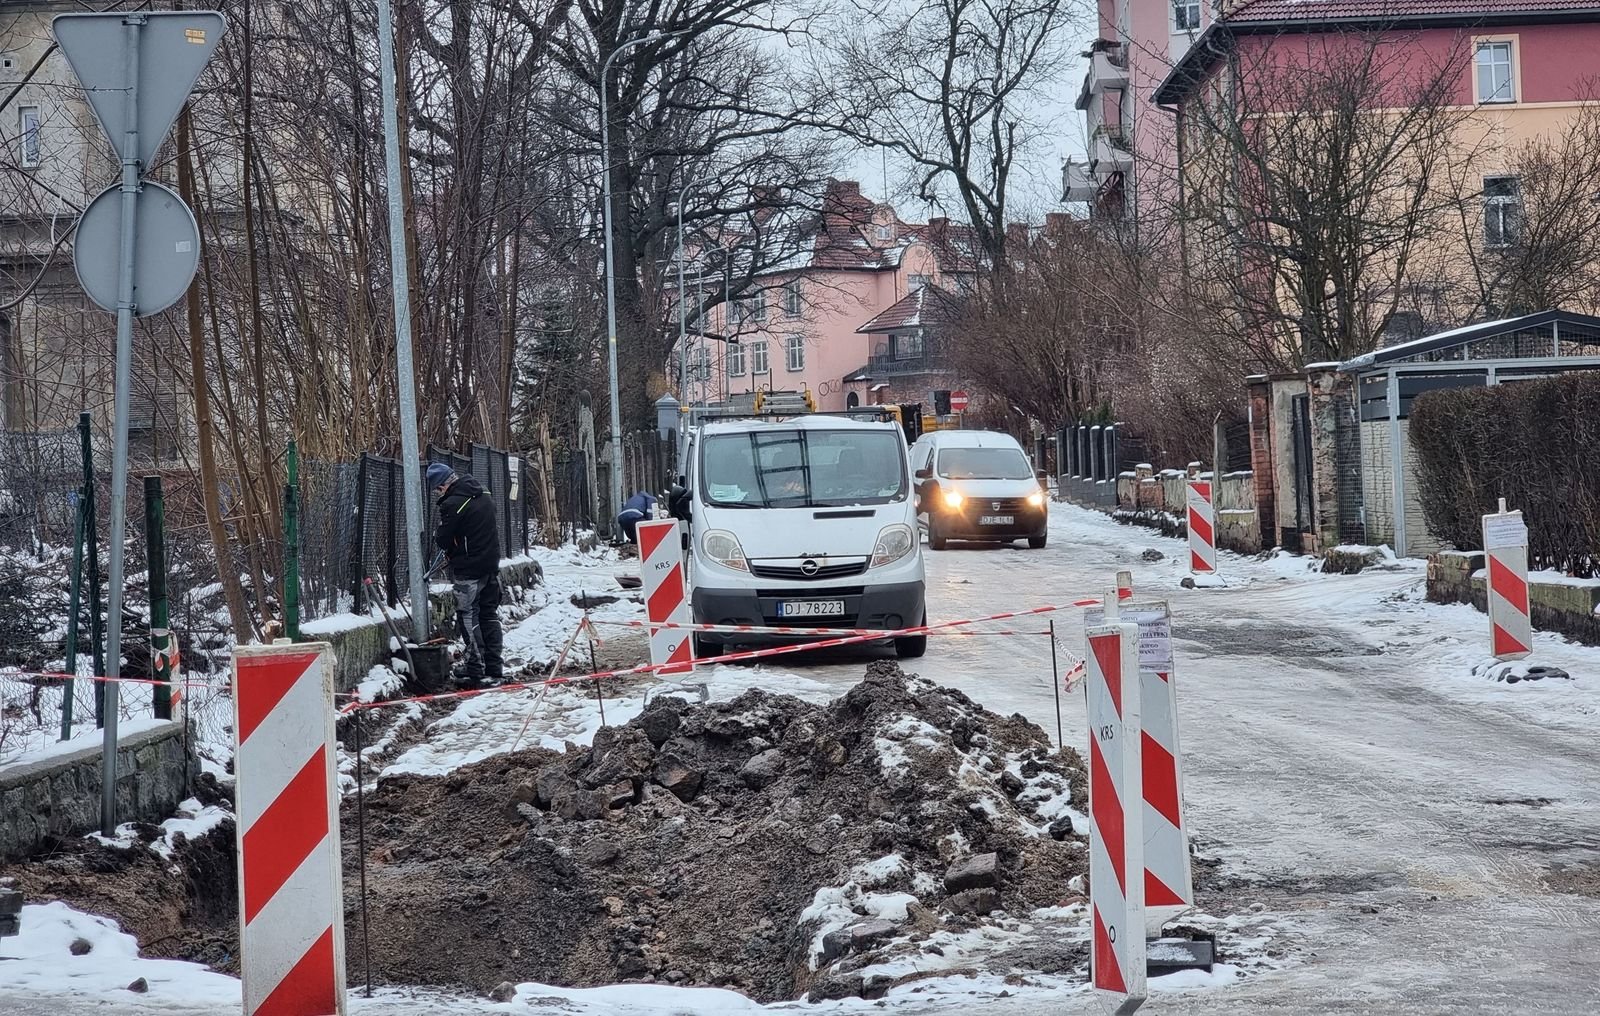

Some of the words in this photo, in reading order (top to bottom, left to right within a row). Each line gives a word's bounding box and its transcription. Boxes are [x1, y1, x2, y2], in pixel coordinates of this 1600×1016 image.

[655, 561, 671, 570] KRS
[785, 603, 801, 615] DJ
[806, 602, 842, 614] 78223
[1100, 724, 1114, 741] KRS
